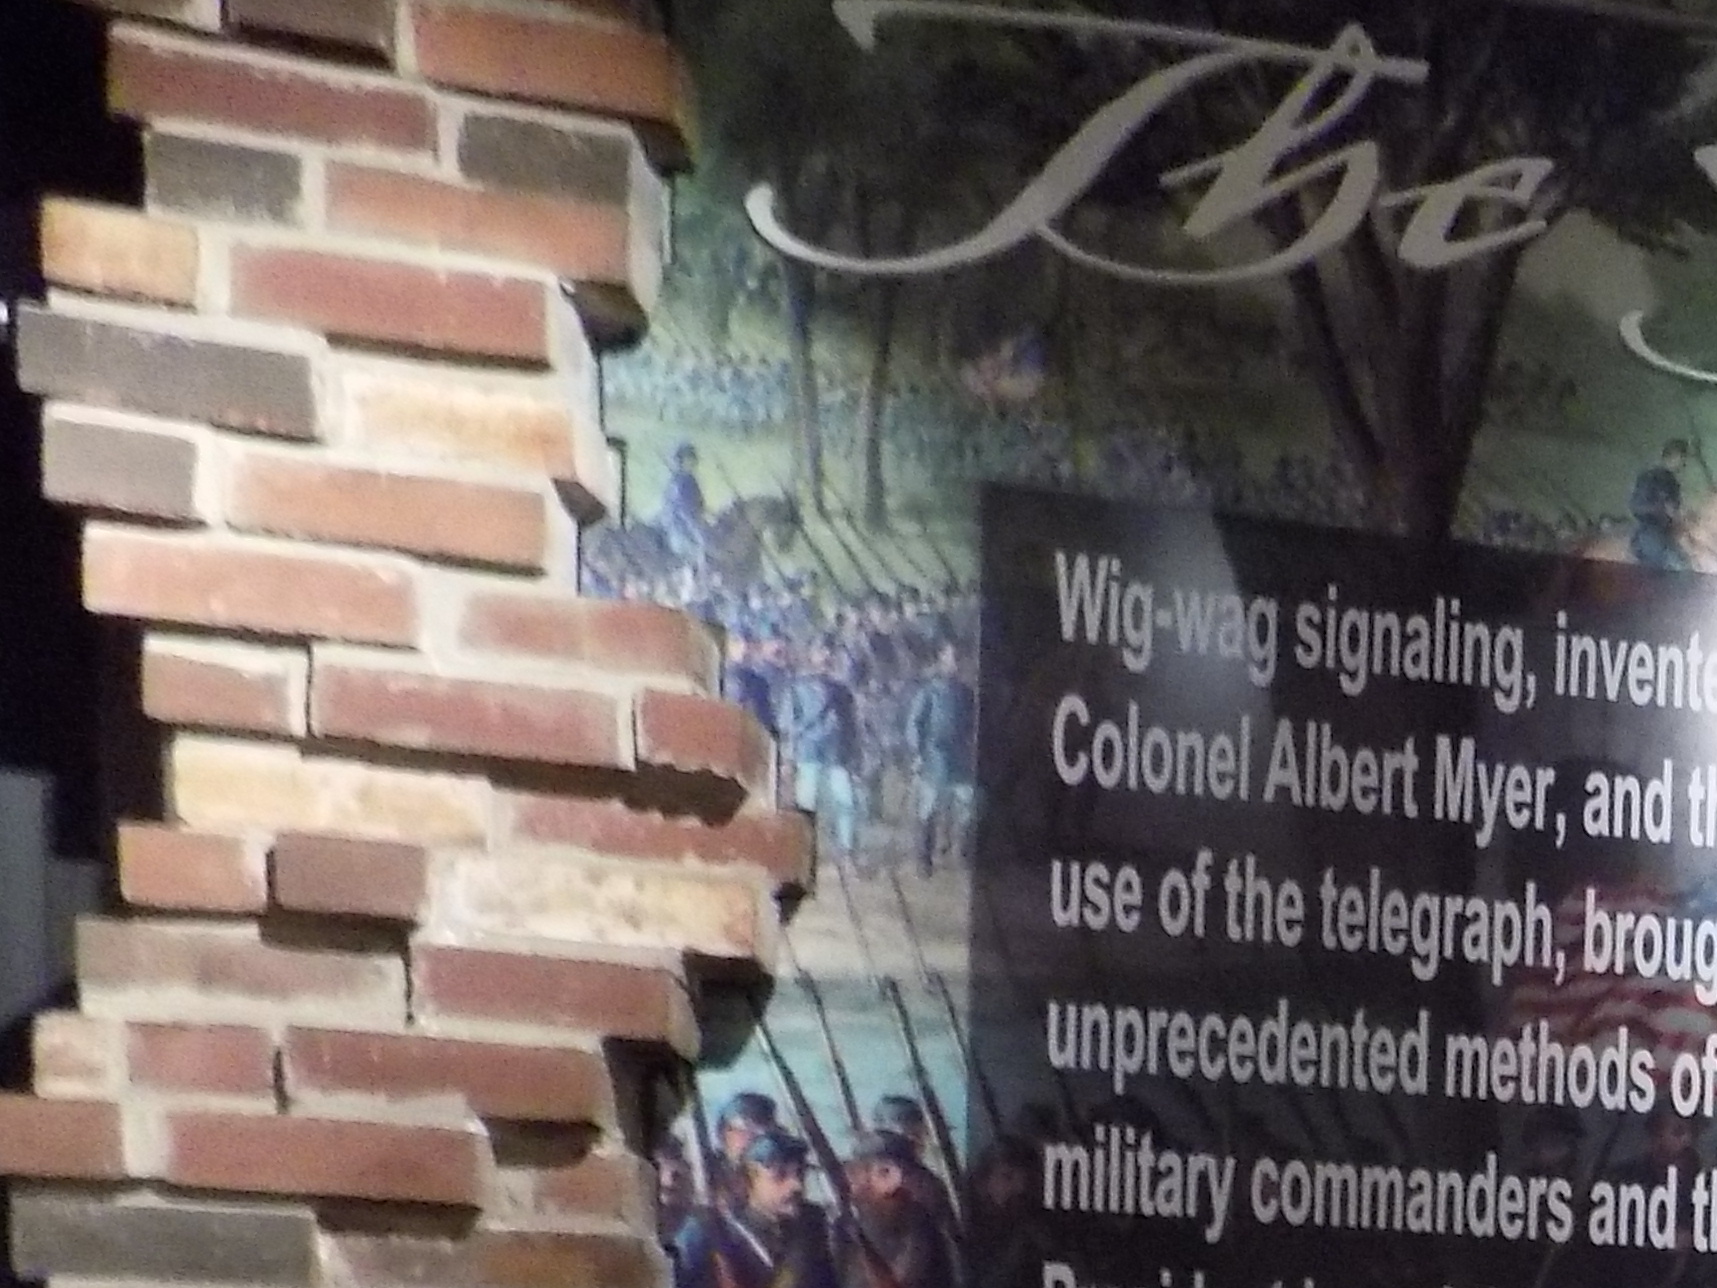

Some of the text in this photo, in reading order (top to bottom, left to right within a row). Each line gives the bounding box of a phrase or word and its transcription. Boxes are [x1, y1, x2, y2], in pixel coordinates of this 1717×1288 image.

[746, 0, 1552, 285] The
[1056, 551, 1278, 686] Wig-wag
[1294, 586, 1537, 713] signaling,
[1053, 693, 1249, 801] Colonel
[1264, 716, 1418, 818] Albert
[1434, 734, 1566, 848] Myer,
[1584, 759, 1671, 842] and
[1051, 854, 1141, 932] use
[1158, 850, 1213, 938] of
[1227, 859, 1301, 945] the
[1321, 867, 1565, 981] telegraph,
[1048, 996, 1428, 1095] unprecedented
[1445, 1015, 1653, 1113] methods
[1044, 1127, 1236, 1243] military
[1251, 1153, 1571, 1243] commanders
[1590, 1170, 1676, 1252] and
